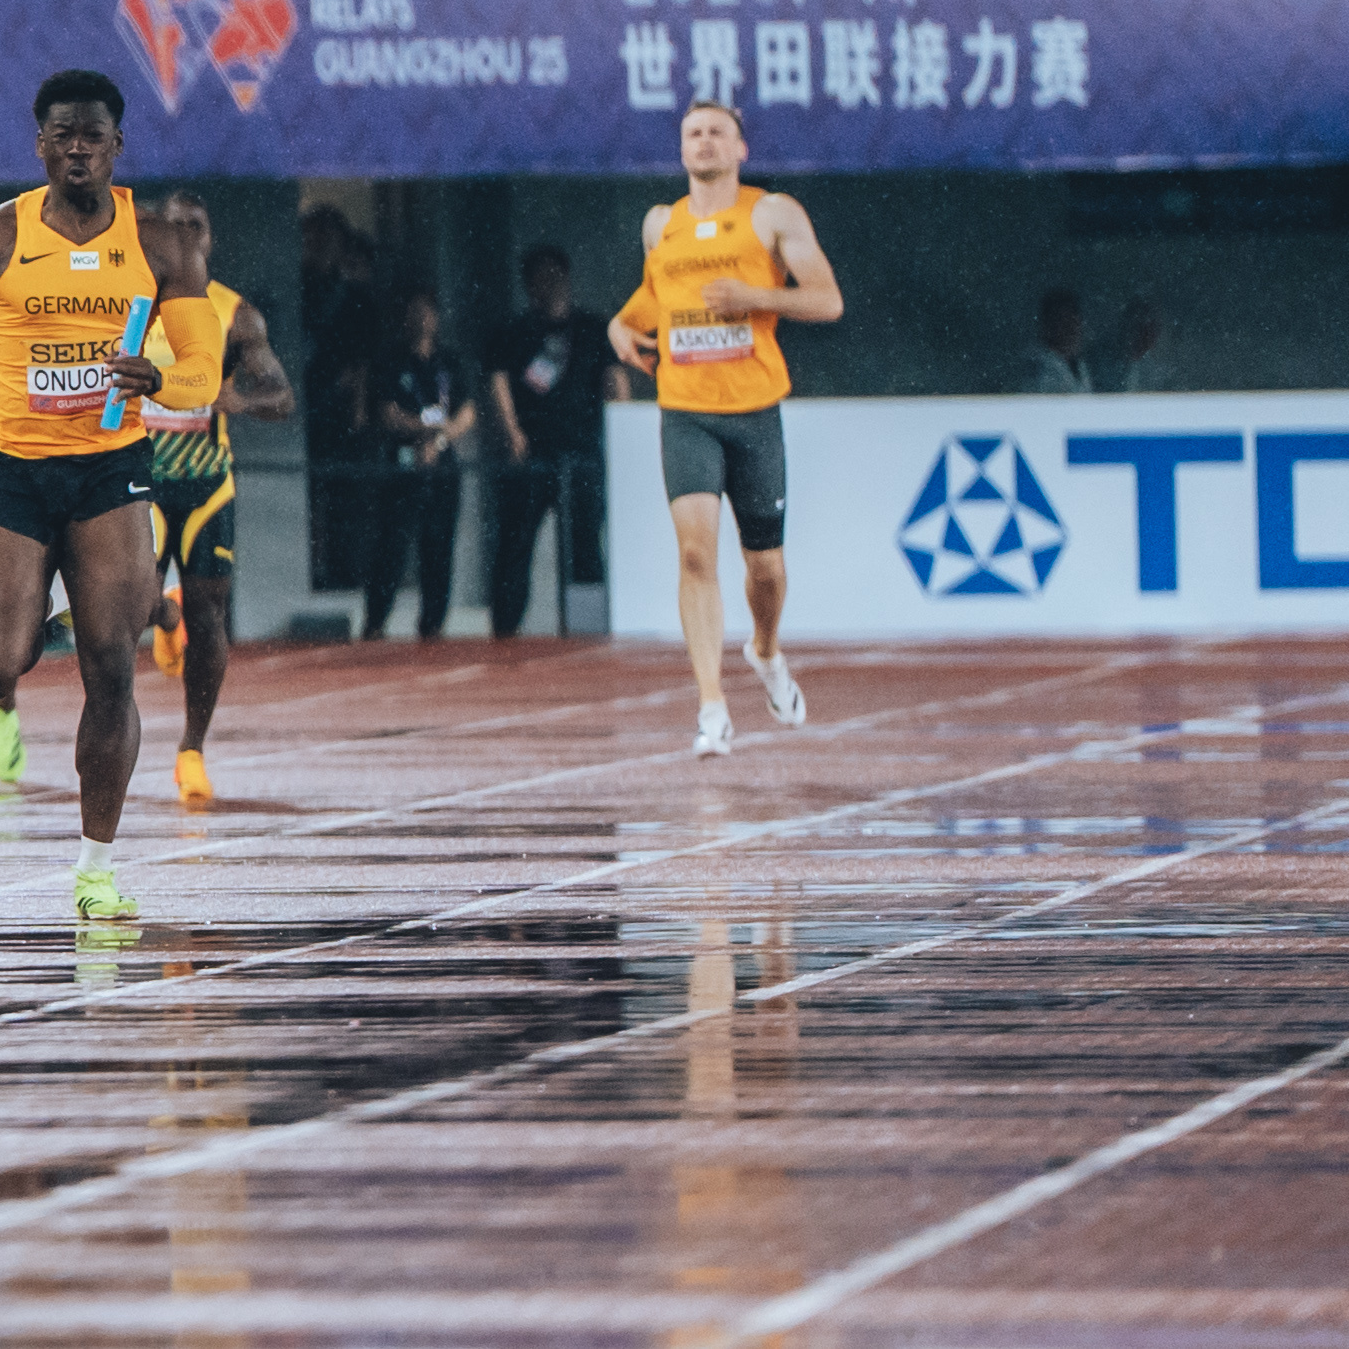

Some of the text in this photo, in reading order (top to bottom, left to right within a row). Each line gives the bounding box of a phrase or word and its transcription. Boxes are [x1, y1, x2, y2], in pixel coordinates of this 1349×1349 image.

[313, 35, 568, 87] GUANGZHOU 25
[620, 15, 1090, 110] 世界田联接力赛
[72, 256, 98, 265] WGV
[34, 367, 113, 391] ONUOH
